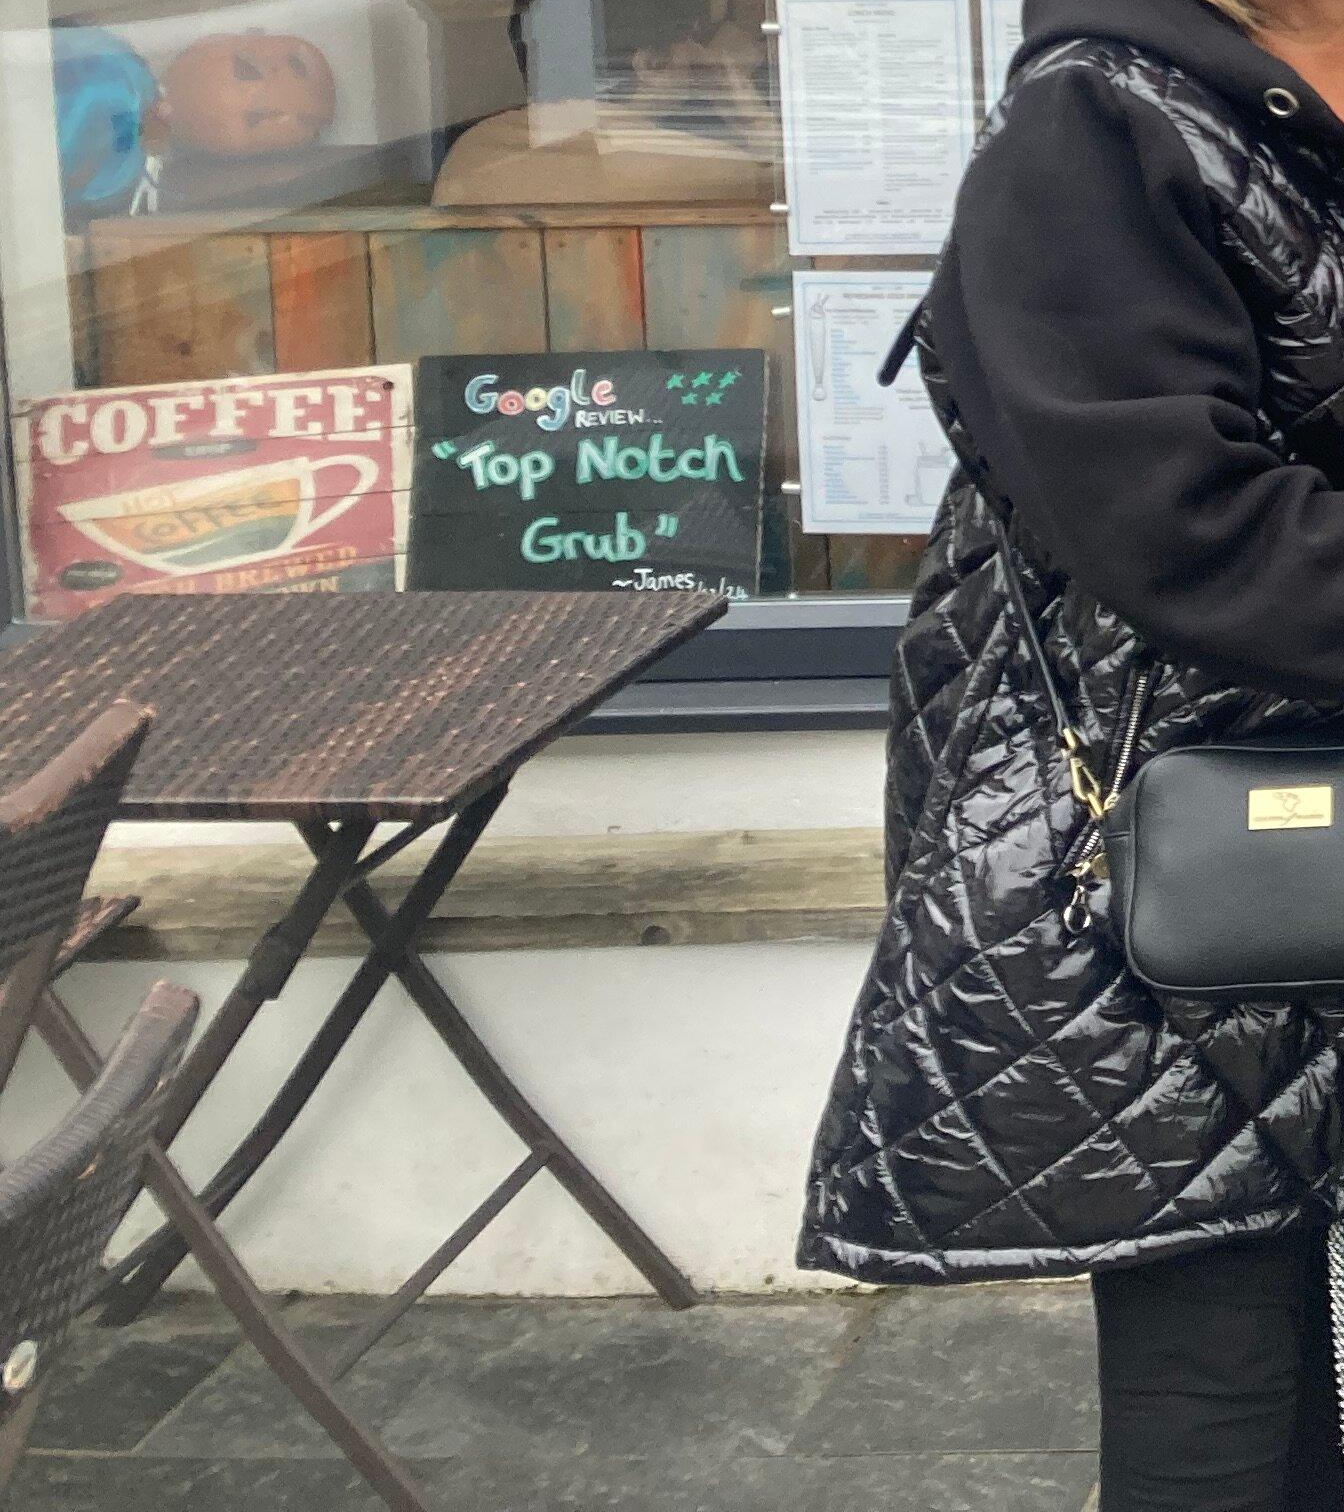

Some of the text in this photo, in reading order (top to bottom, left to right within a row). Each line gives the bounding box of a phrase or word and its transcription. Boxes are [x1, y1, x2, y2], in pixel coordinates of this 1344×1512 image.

[38, 384, 382, 465] COFFEE
[465, 369, 617, 431] Google
[575, 433, 746, 485] Notch
